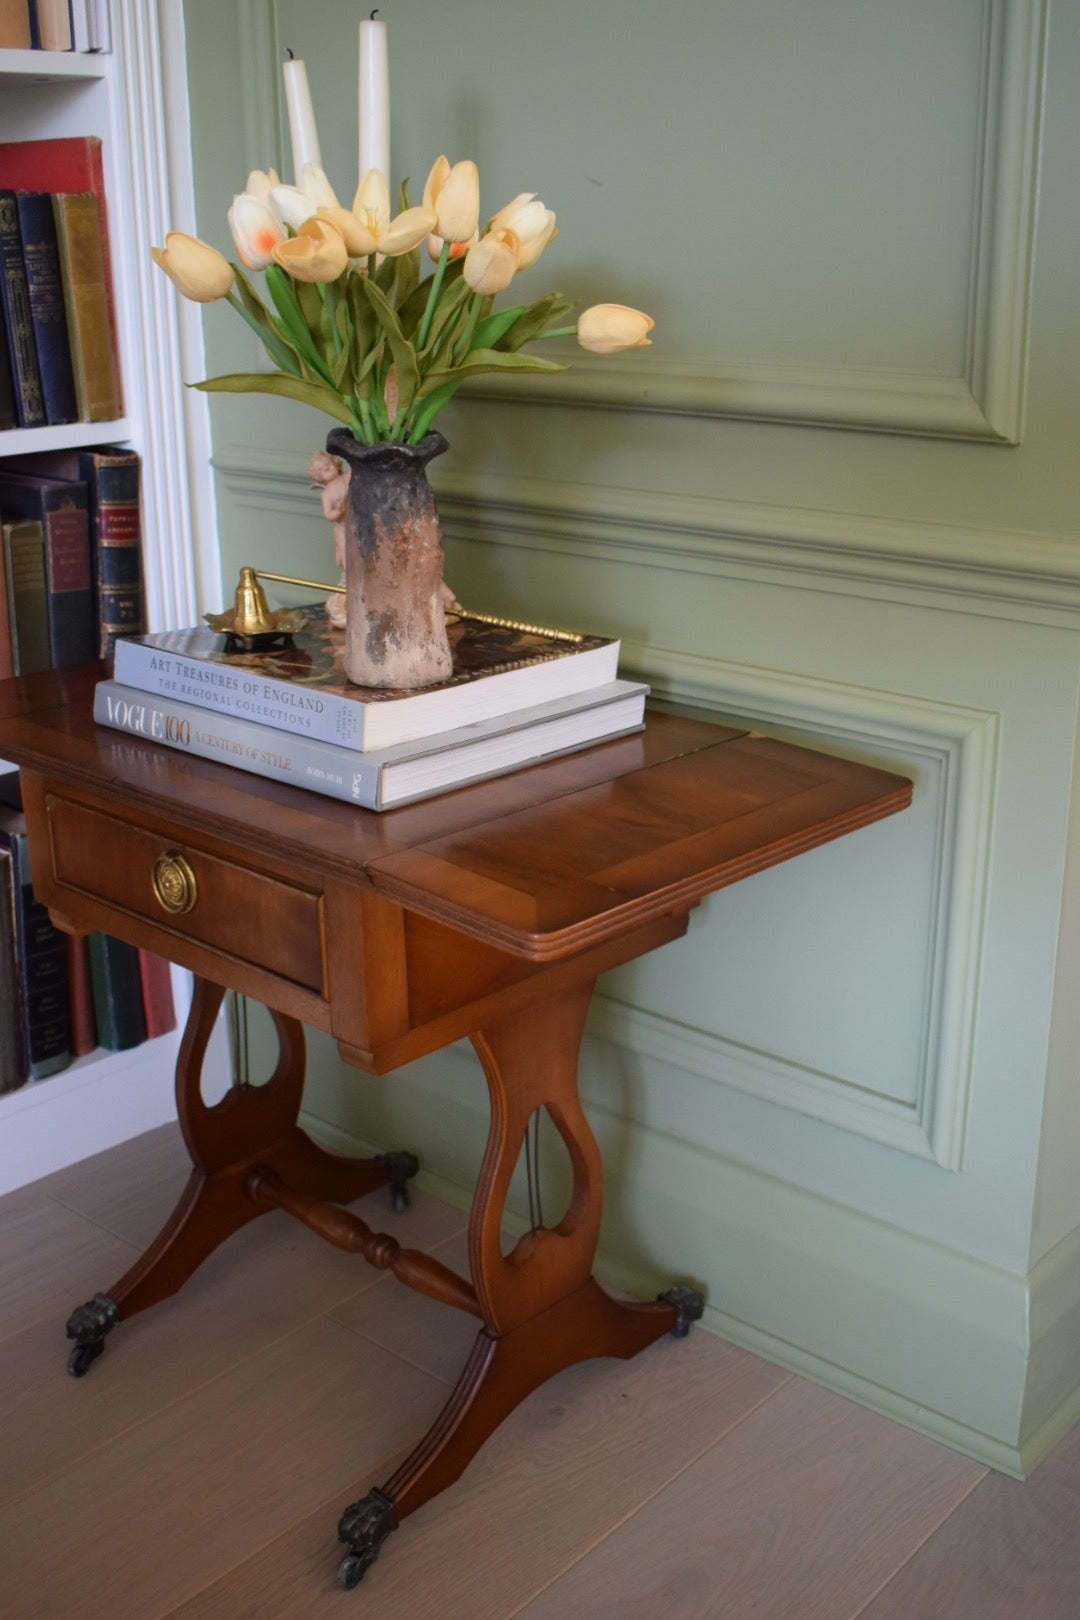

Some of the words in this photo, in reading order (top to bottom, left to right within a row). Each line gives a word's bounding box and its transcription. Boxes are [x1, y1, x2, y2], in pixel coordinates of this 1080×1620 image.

[150, 655, 171, 673] ART
[175, 662, 239, 692] TREASURES
[243, 681, 260, 697] OF
[263, 684, 325, 714] ENGLAND
[159, 678, 177, 691] THE
[181, 684, 232, 706] REGIONAL
[235, 699, 312, 729] COLLECTIONS
[106, 696, 163, 739] VOGUE
[165, 714, 191, 747] 100
[202, 732, 243, 755] CENTURY
[246, 743, 260, 760] OF
[260, 751, 292, 771] STYLE
[352, 773, 363, 799] NPG
